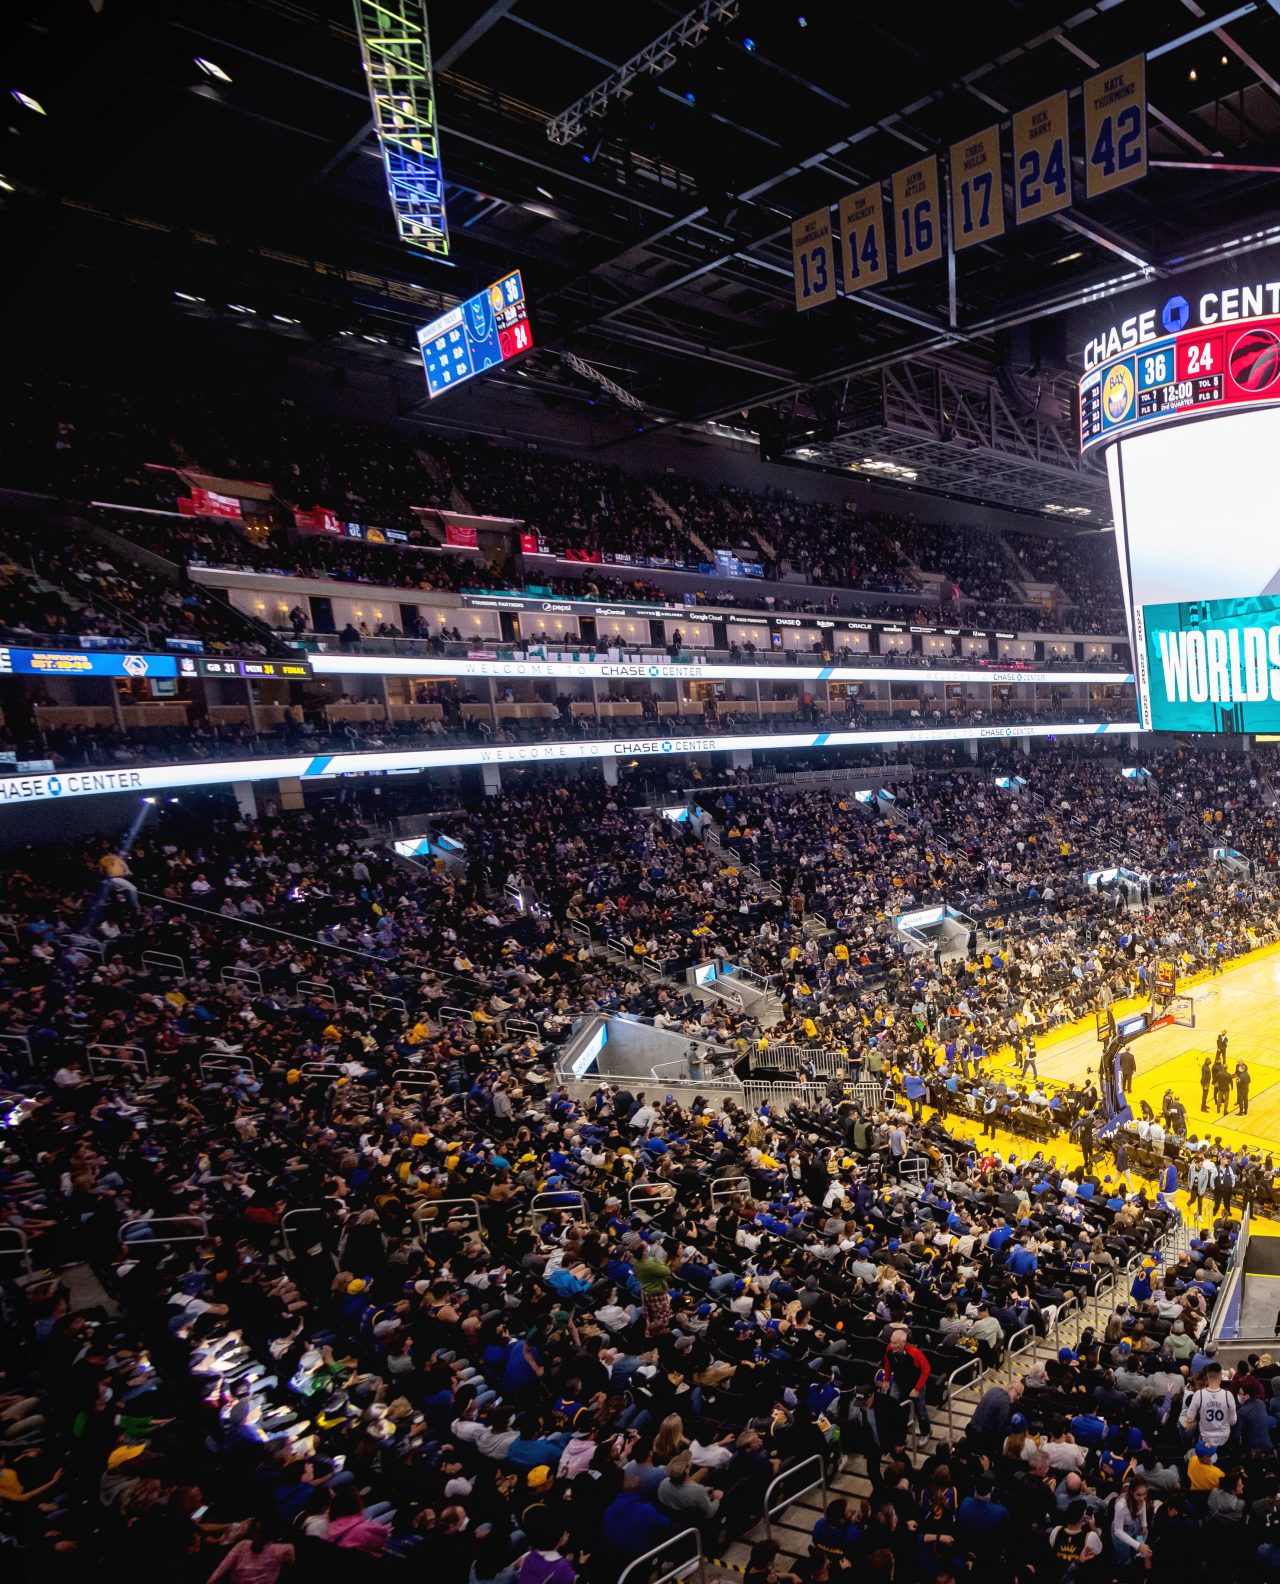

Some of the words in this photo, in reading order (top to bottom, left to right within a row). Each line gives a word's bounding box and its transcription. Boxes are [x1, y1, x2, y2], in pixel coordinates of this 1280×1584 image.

[1104, 74, 1125, 93] NATE
[1094, 82, 1136, 110] THURMOND
[1032, 110, 1048, 126] RICK
[1029, 121, 1052, 140] BARRY
[965, 142, 984, 157] CHRIS
[1091, 104, 1142, 177] 42
[1019, 138, 1066, 209] 24
[961, 171, 992, 233] 17
[902, 199, 933, 257] 16
[849, 224, 879, 278] 14
[801, 246, 828, 297] 13
[505, 277, 518, 303] 36
[514, 324, 528, 349] 24
[1083, 309, 1157, 371] CHASE
[1187, 343, 1213, 374] 24
[1145, 354, 1166, 385] 36
[1109, 371, 1125, 389] BAY
[1199, 380, 1211, 388] TOL
[1214, 377, 1218, 387] 5
[1153, 390, 1157, 399] 7
[1163, 382, 1192, 402] 12:00
[1199, 392, 1210, 400] FLS
[1170, 399, 1194, 409] QUARTER
[551, 604, 572, 612] pepsi
[689, 612, 708, 621] Google
[206, 663, 221, 672] GB
[224, 663, 235, 674] 31
[282, 666, 306, 675] FINAL
[466, 664, 554, 674] WELCOME
[567, 665, 586, 675] TO
[601, 666, 646, 676] CHASE
[662, 667, 702, 676] CENTER
[980, 729, 1004, 737] CHASE
[480, 747, 566, 761] WELCOME
[580, 746, 598, 754] TO
[614, 742, 659, 754] CHASE
[675, 740, 716, 751] CENTER
[68, 772, 142, 792] CENTER
[1158, 970, 1172, 981] 24
[1206, 1409, 1224, 1422] 30
